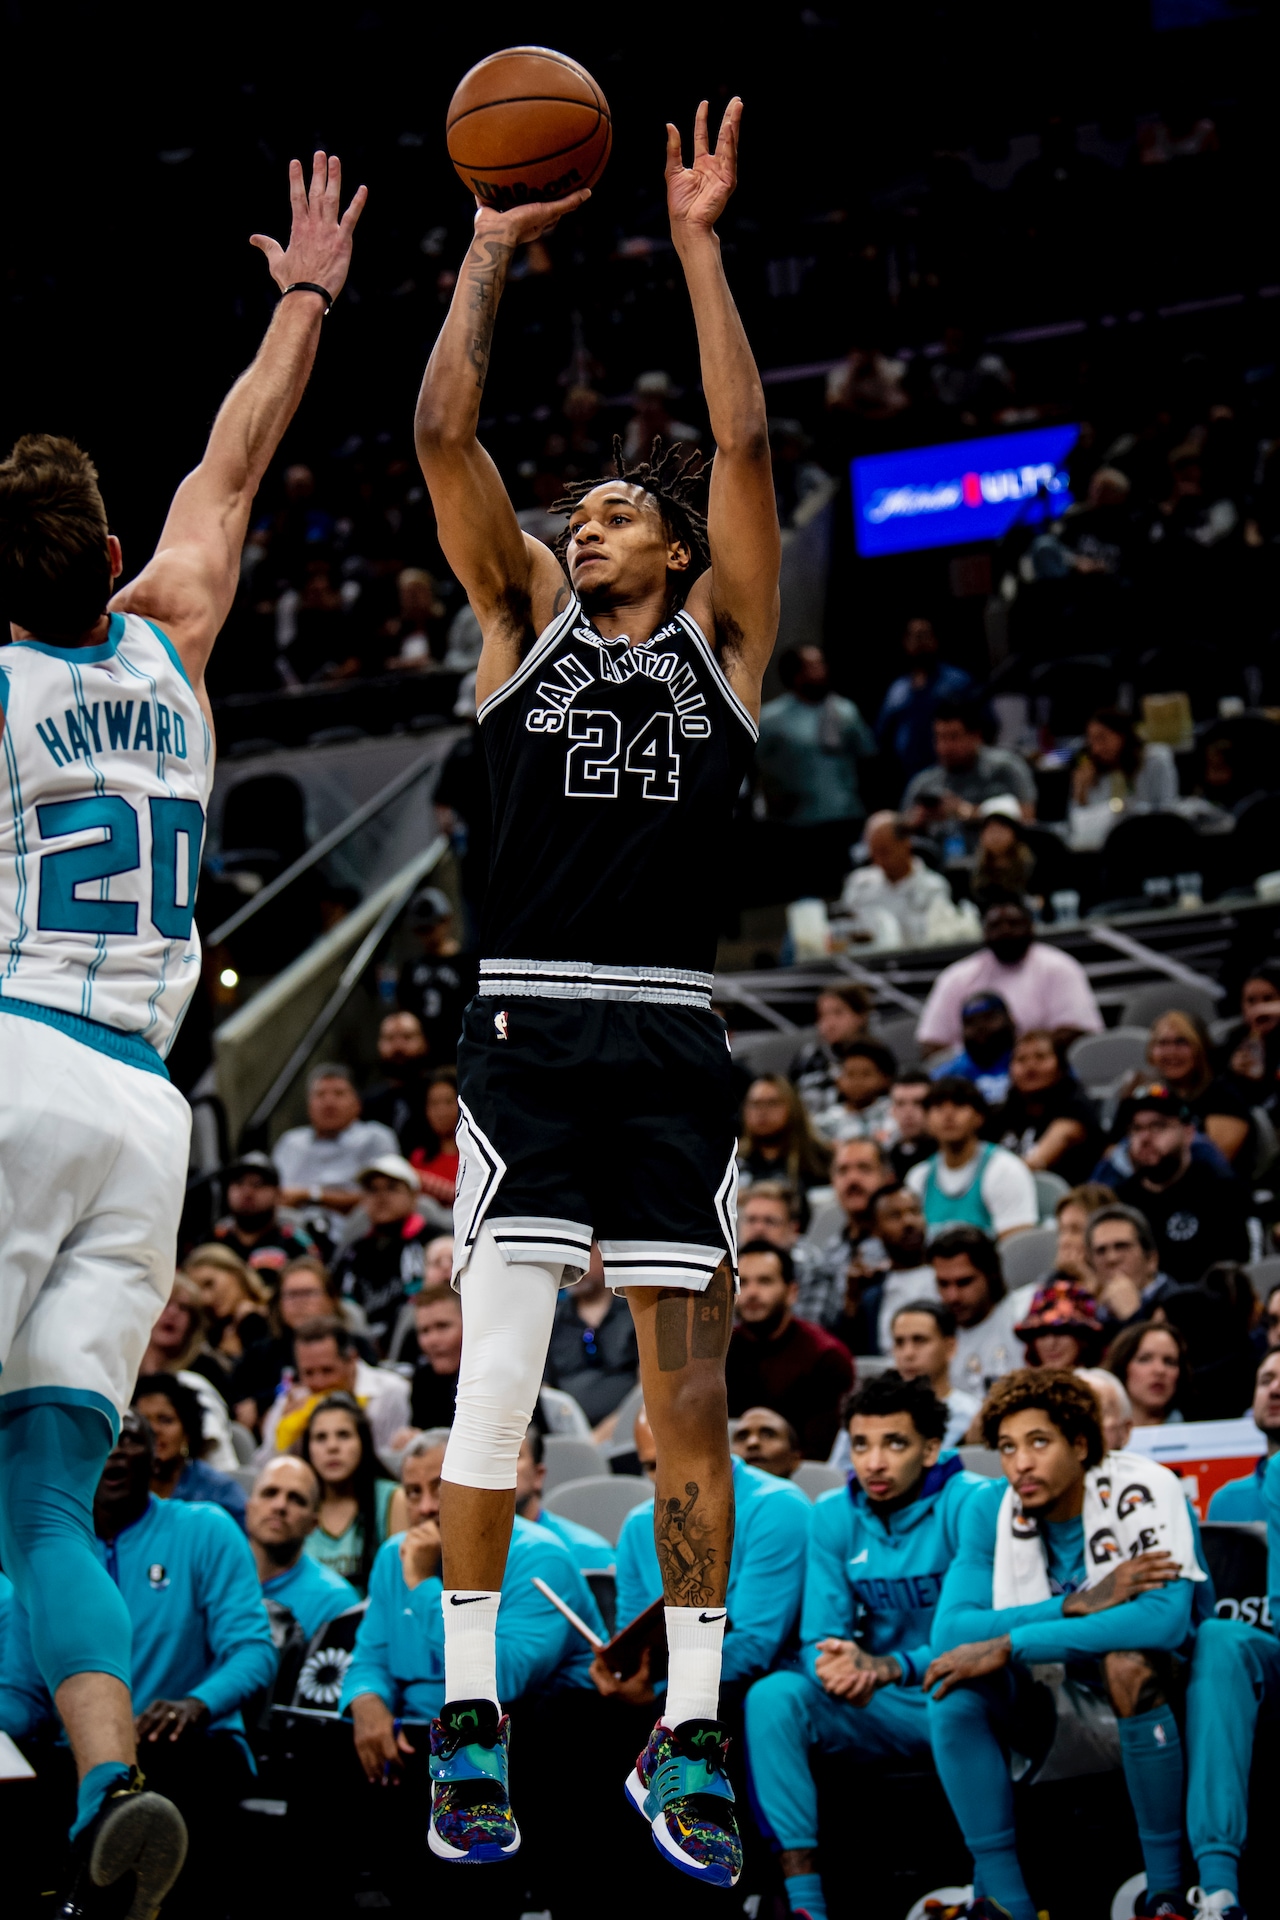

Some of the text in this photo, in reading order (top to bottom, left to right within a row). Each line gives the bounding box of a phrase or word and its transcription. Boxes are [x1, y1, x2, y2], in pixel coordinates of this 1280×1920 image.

[35, 700, 187, 768] HAYWARD
[525, 647, 711, 738] SAN ANTONIO
[565, 709, 681, 801] 24
[36, 795, 205, 940] 20
